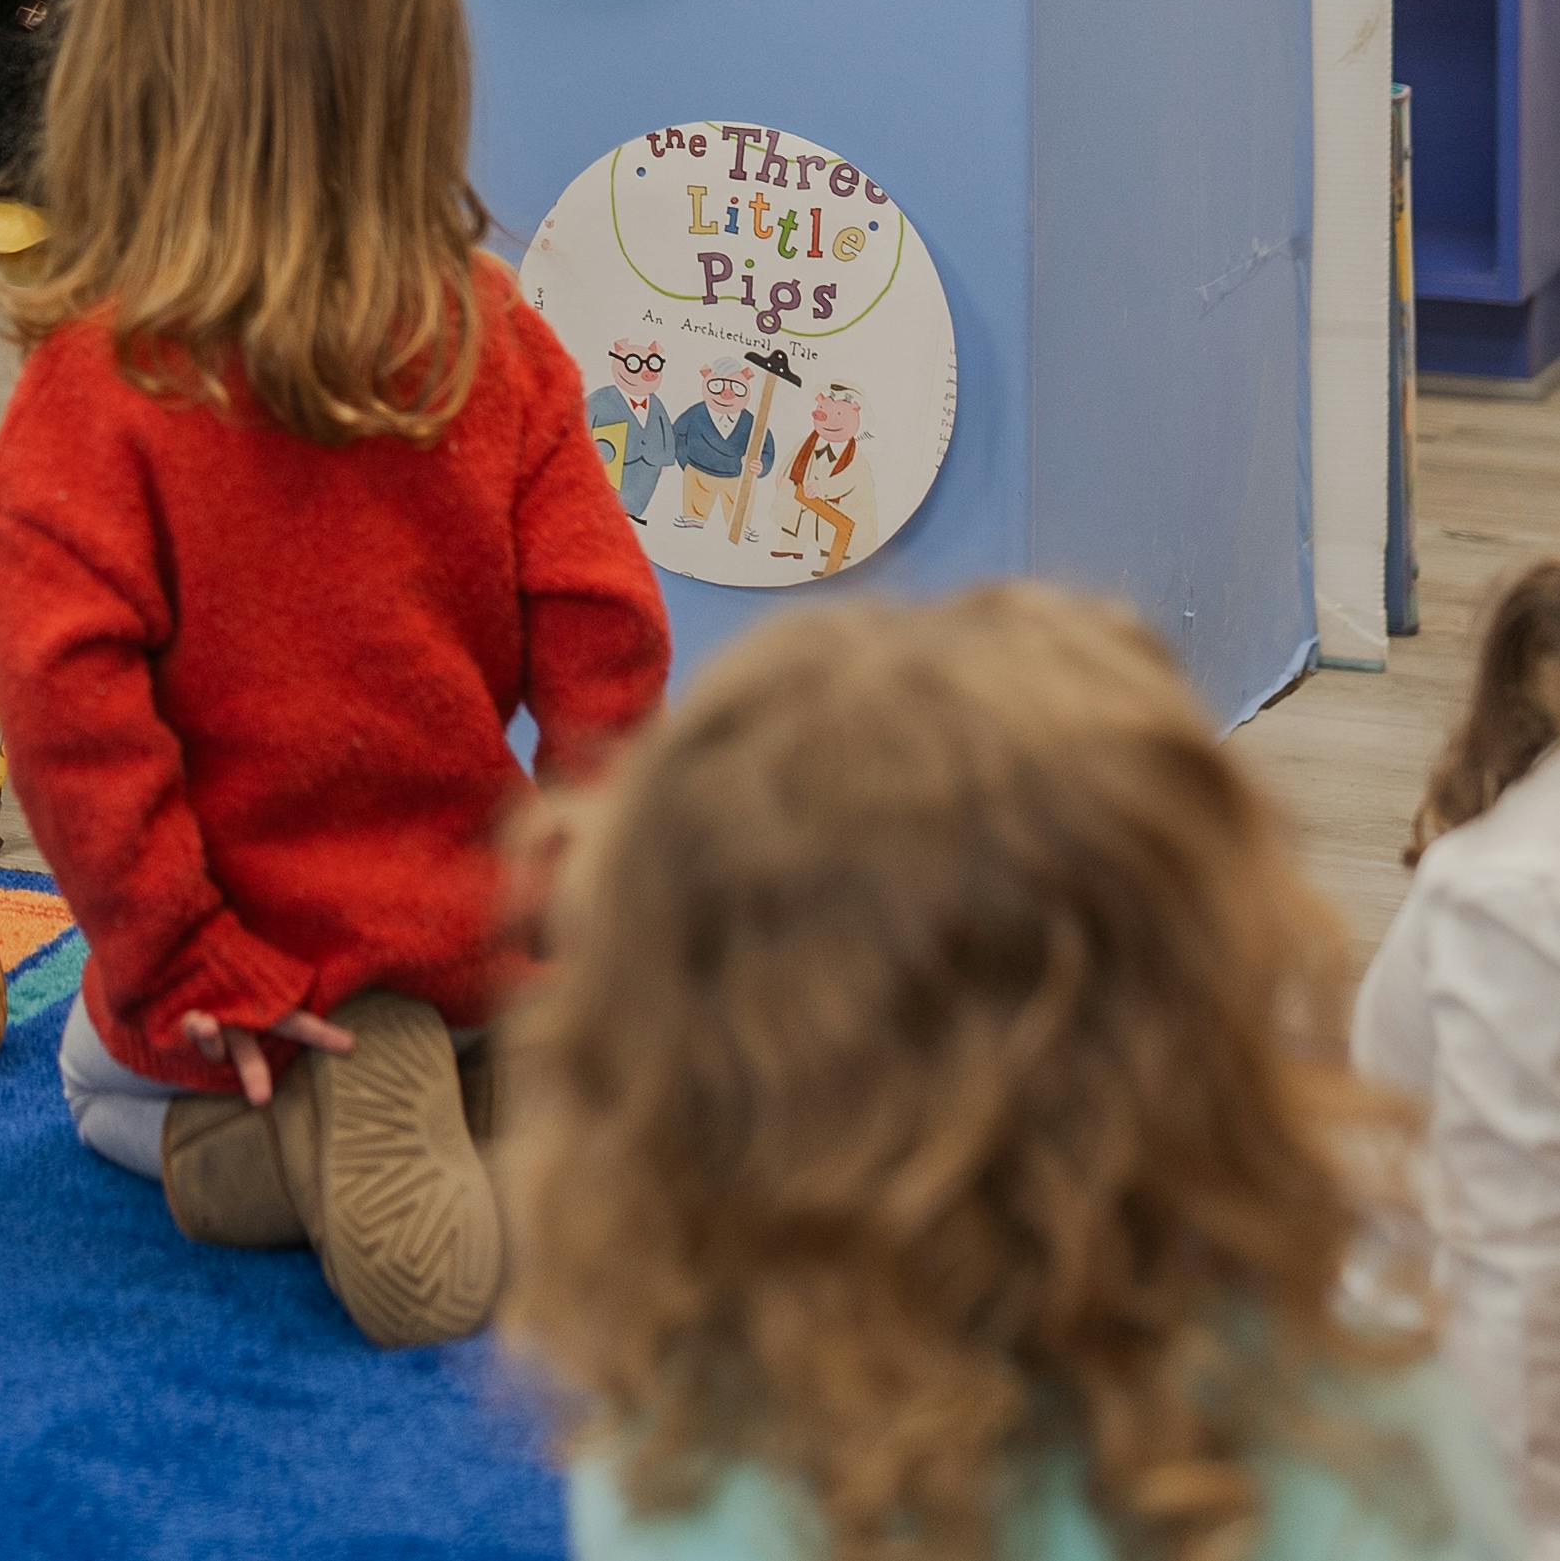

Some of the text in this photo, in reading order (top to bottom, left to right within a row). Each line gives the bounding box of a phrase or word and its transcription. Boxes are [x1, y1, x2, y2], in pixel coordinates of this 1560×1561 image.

[647, 126, 888, 205] the Three
[687, 185, 866, 262] Little
[697, 252, 836, 334] Pigs
[642, 309, 818, 360] An Architectural Tale
